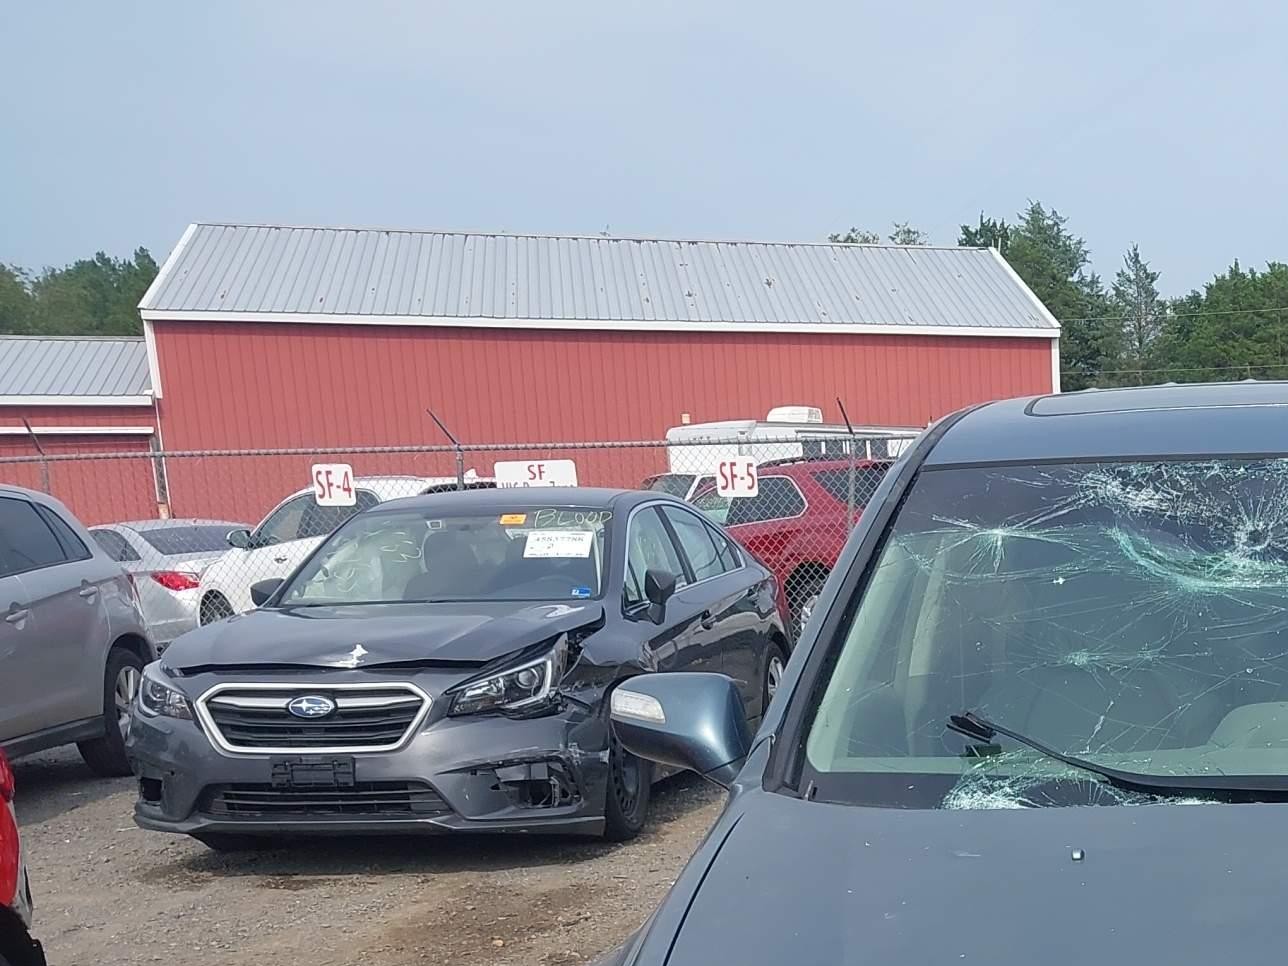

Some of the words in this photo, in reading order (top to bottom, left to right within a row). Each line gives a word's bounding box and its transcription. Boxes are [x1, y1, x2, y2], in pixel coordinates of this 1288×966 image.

[527, 464, 545, 480] SF
[719, 462, 755, 490] SF-5
[315, 470, 352, 499] SF-4
[534, 508, 613, 528] BLOOD
